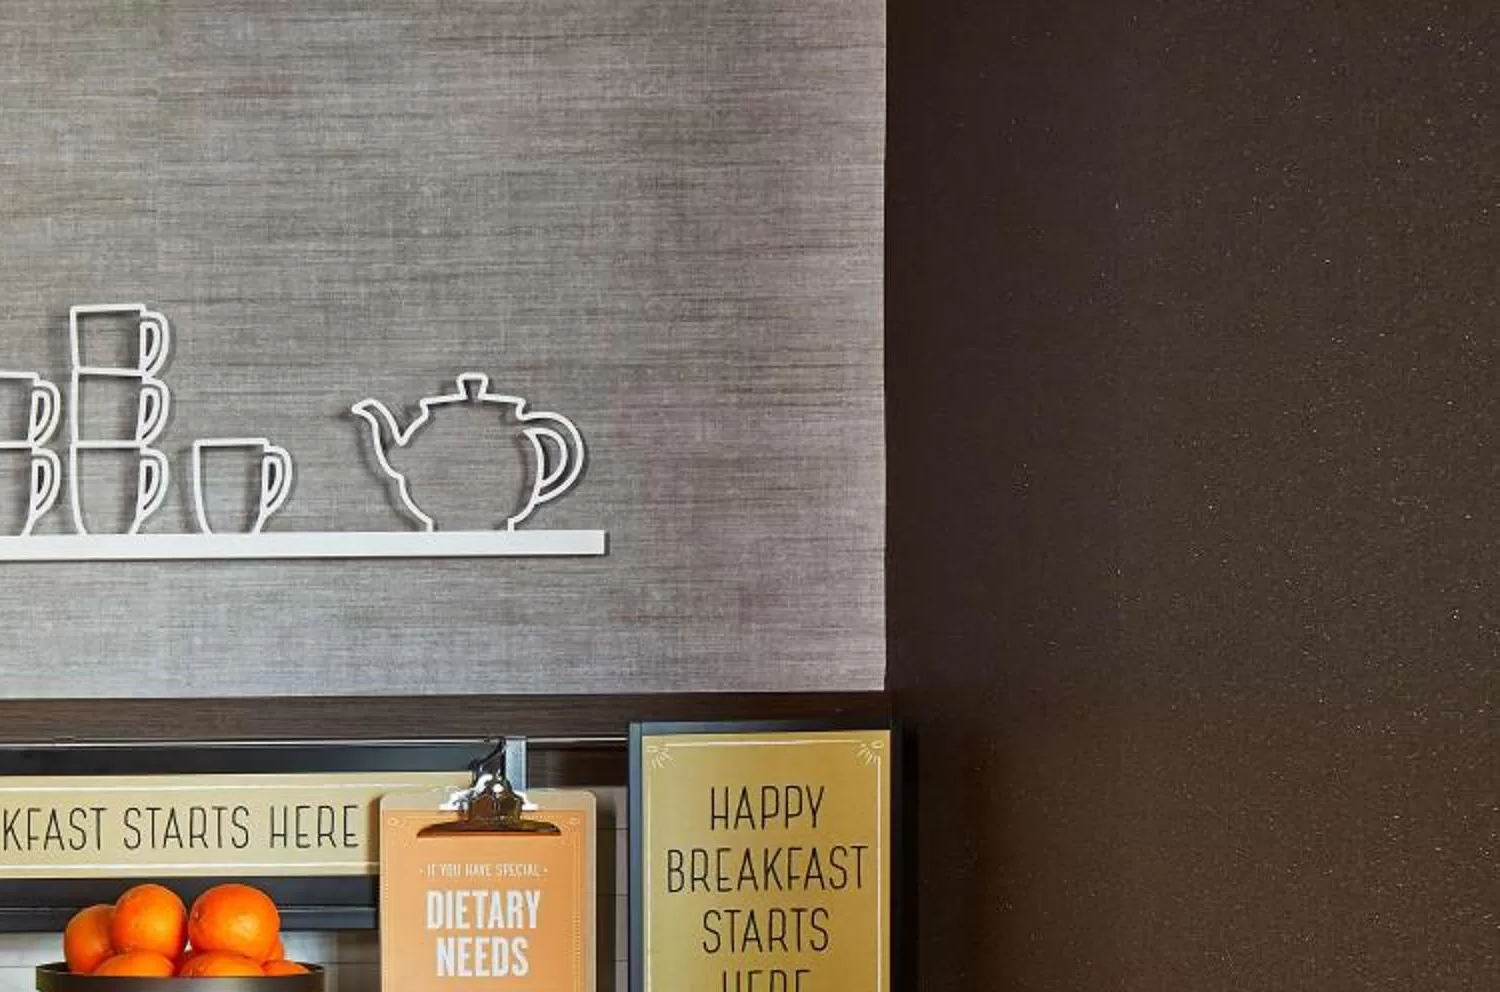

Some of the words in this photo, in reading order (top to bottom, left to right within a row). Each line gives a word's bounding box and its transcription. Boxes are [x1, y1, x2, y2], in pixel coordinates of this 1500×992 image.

[122, 805, 250, 851] STARTS
[269, 805, 360, 849] HERE
[709, 785, 825, 831] HAPPY
[495, 863, 539, 877] SPECIAL
[666, 845, 868, 893] BREAKFAST
[426, 889, 541, 929] DIETARY
[702, 907, 830, 953] STARTS
[436, 936, 530, 977] NEEDS
